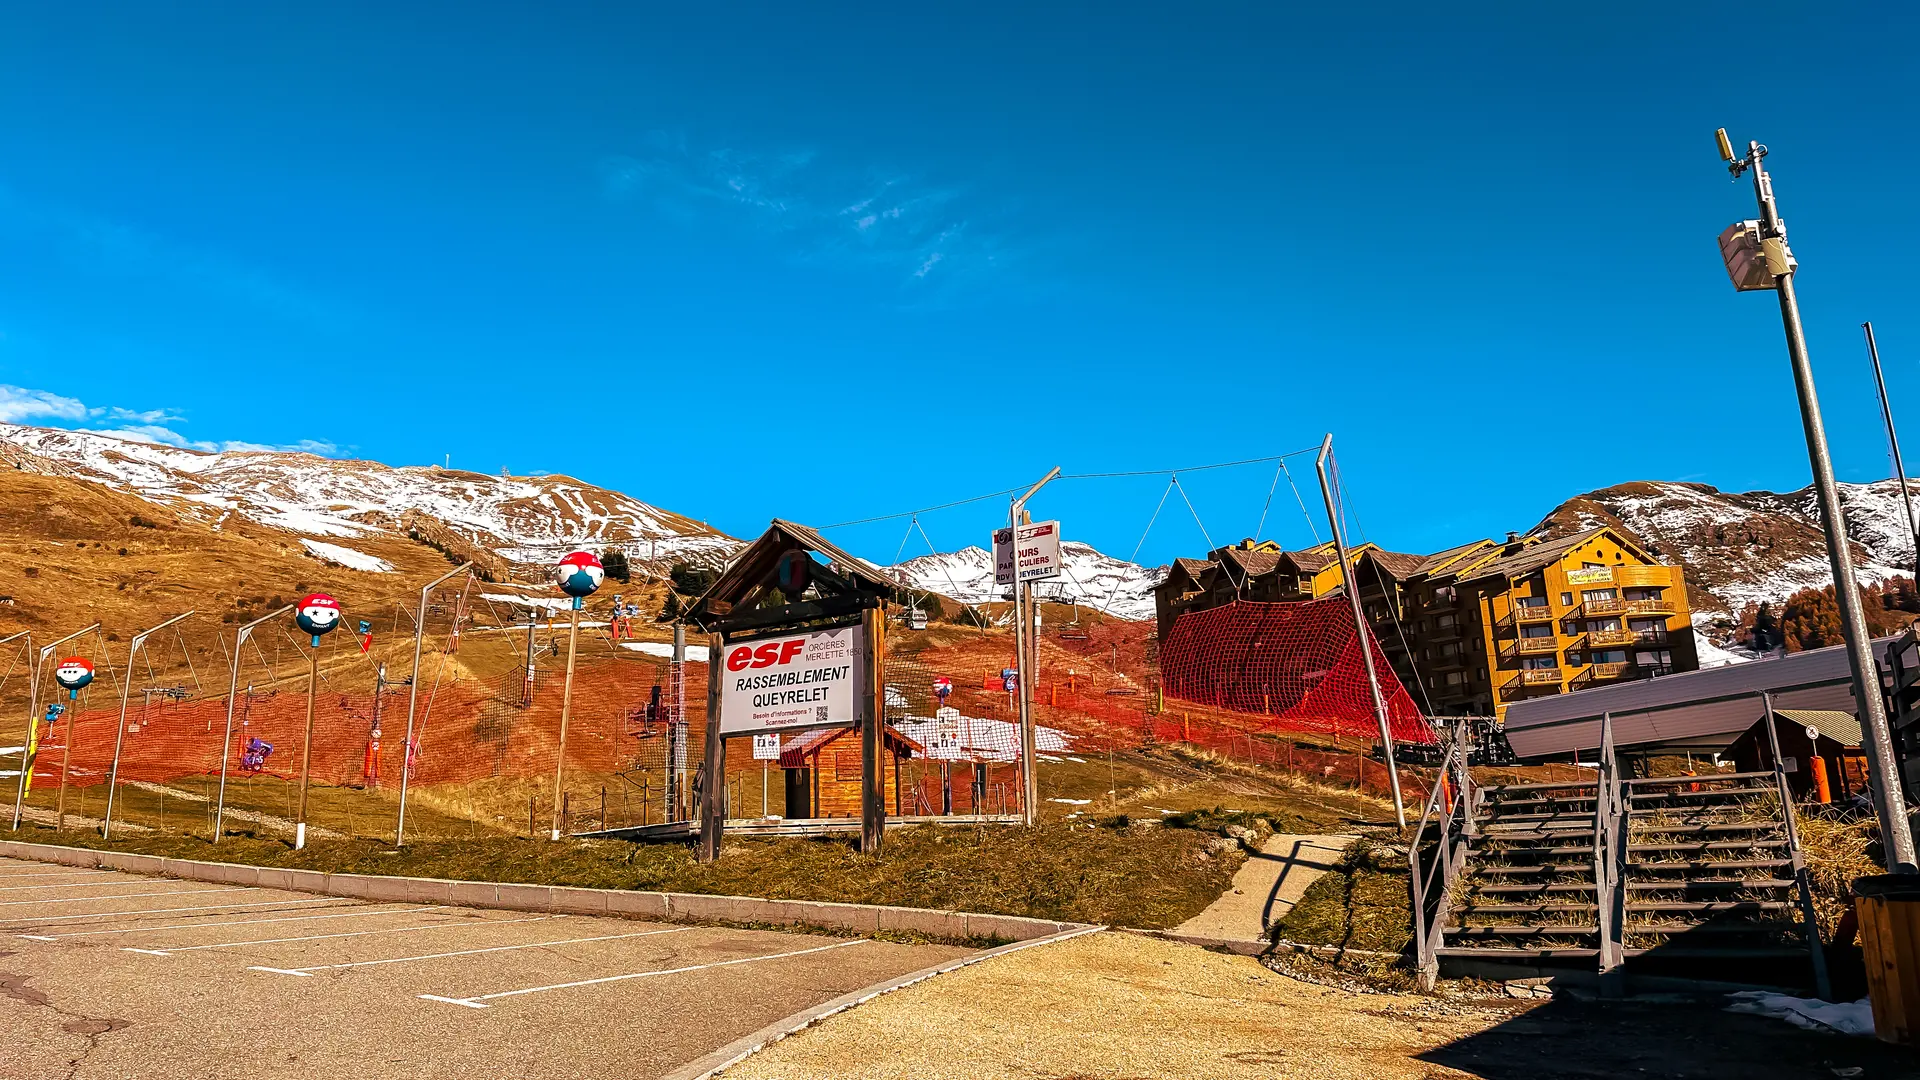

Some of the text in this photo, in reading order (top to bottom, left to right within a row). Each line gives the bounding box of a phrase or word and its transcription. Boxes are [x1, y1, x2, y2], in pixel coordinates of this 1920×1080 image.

[999, 556, 1049, 570] PARCULIERS
[806, 650, 843, 661] MERLETTE
[736, 665, 849, 691] RASSEMBLEMENT
[753, 687, 829, 707] QUEYRELET
[770, 709, 807, 718] d'informations
